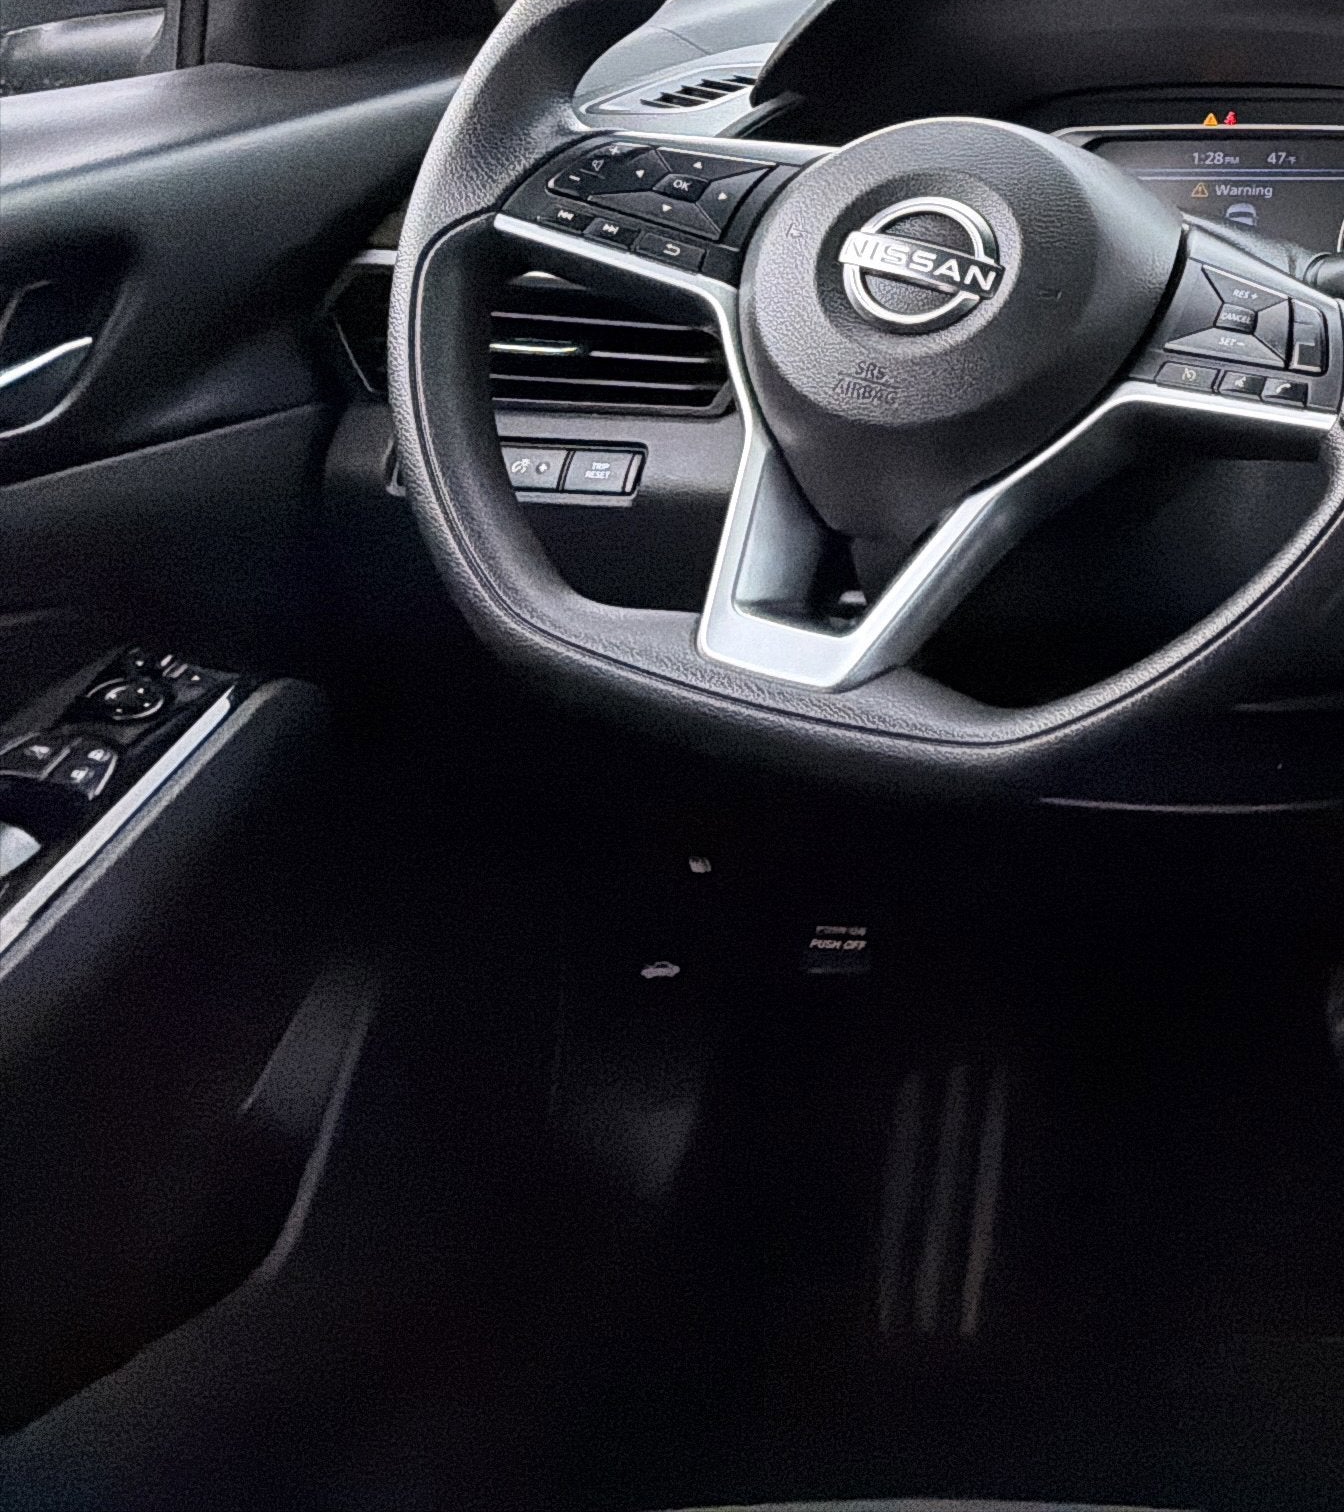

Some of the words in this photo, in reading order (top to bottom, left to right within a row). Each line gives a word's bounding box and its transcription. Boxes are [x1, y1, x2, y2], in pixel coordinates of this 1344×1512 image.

[673, 179, 692, 191] OK
[1215, 184, 1273, 199] Warning
[845, 239, 997, 291] NISSAN
[1232, 289, 1249, 299] RES
[1221, 312, 1251, 323] CANCEL
[1218, 337, 1236, 346] SET
[855, 361, 887, 380] SRS
[833, 378, 897, 405] AIRBAG
[592, 461, 611, 470] TRIP
[585, 470, 611, 479] RESET
